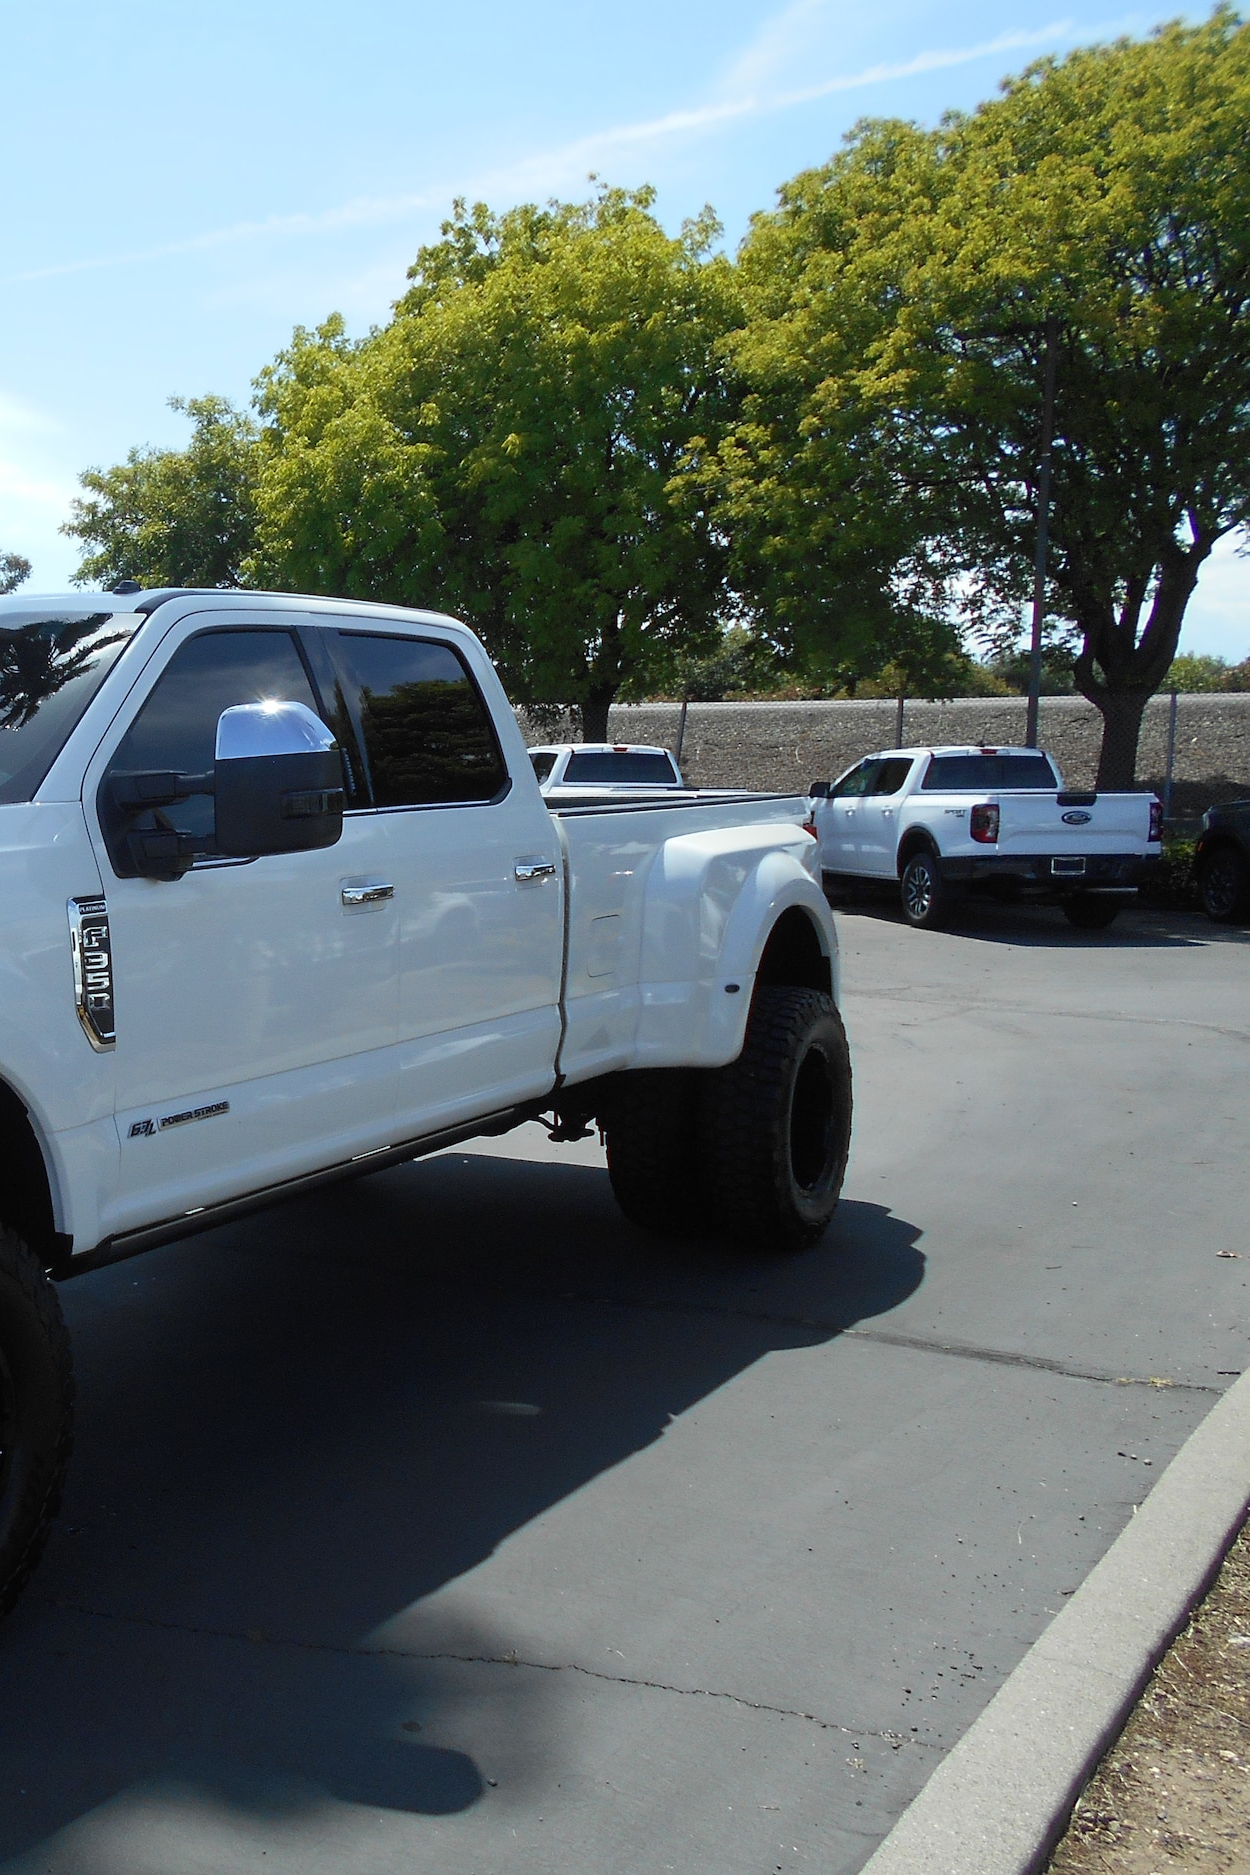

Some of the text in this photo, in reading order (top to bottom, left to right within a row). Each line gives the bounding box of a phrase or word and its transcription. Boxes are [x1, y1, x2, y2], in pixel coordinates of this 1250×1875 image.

[79, 903, 106, 914] PLATINUM
[161, 1111, 193, 1127] POWER
[193, 1101, 229, 1118] STROKE
